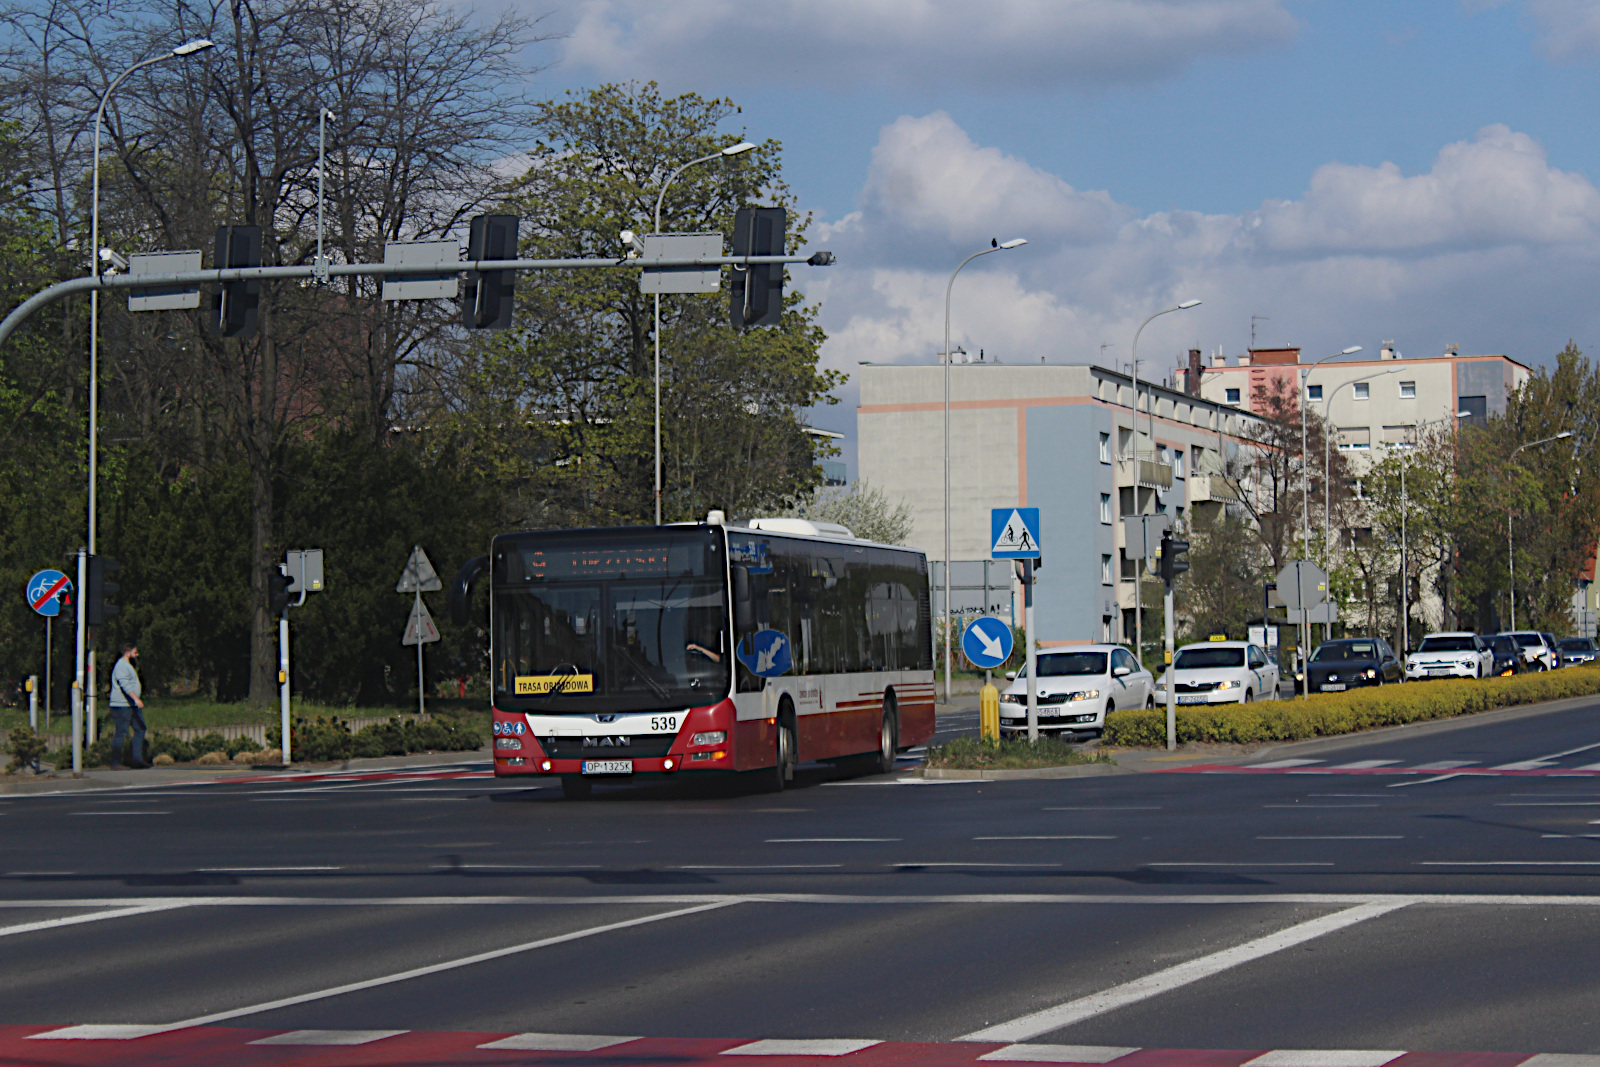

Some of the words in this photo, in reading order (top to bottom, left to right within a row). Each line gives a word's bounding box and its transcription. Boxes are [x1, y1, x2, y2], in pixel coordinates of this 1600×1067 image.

[519, 682, 542, 692] TRASA
[543, 681, 589, 691] OBDOWA
[651, 716, 676, 731] 539
[583, 736, 631, 747] MAN
[587, 761, 600, 771] OP
[604, 761, 631, 771] 1325K
